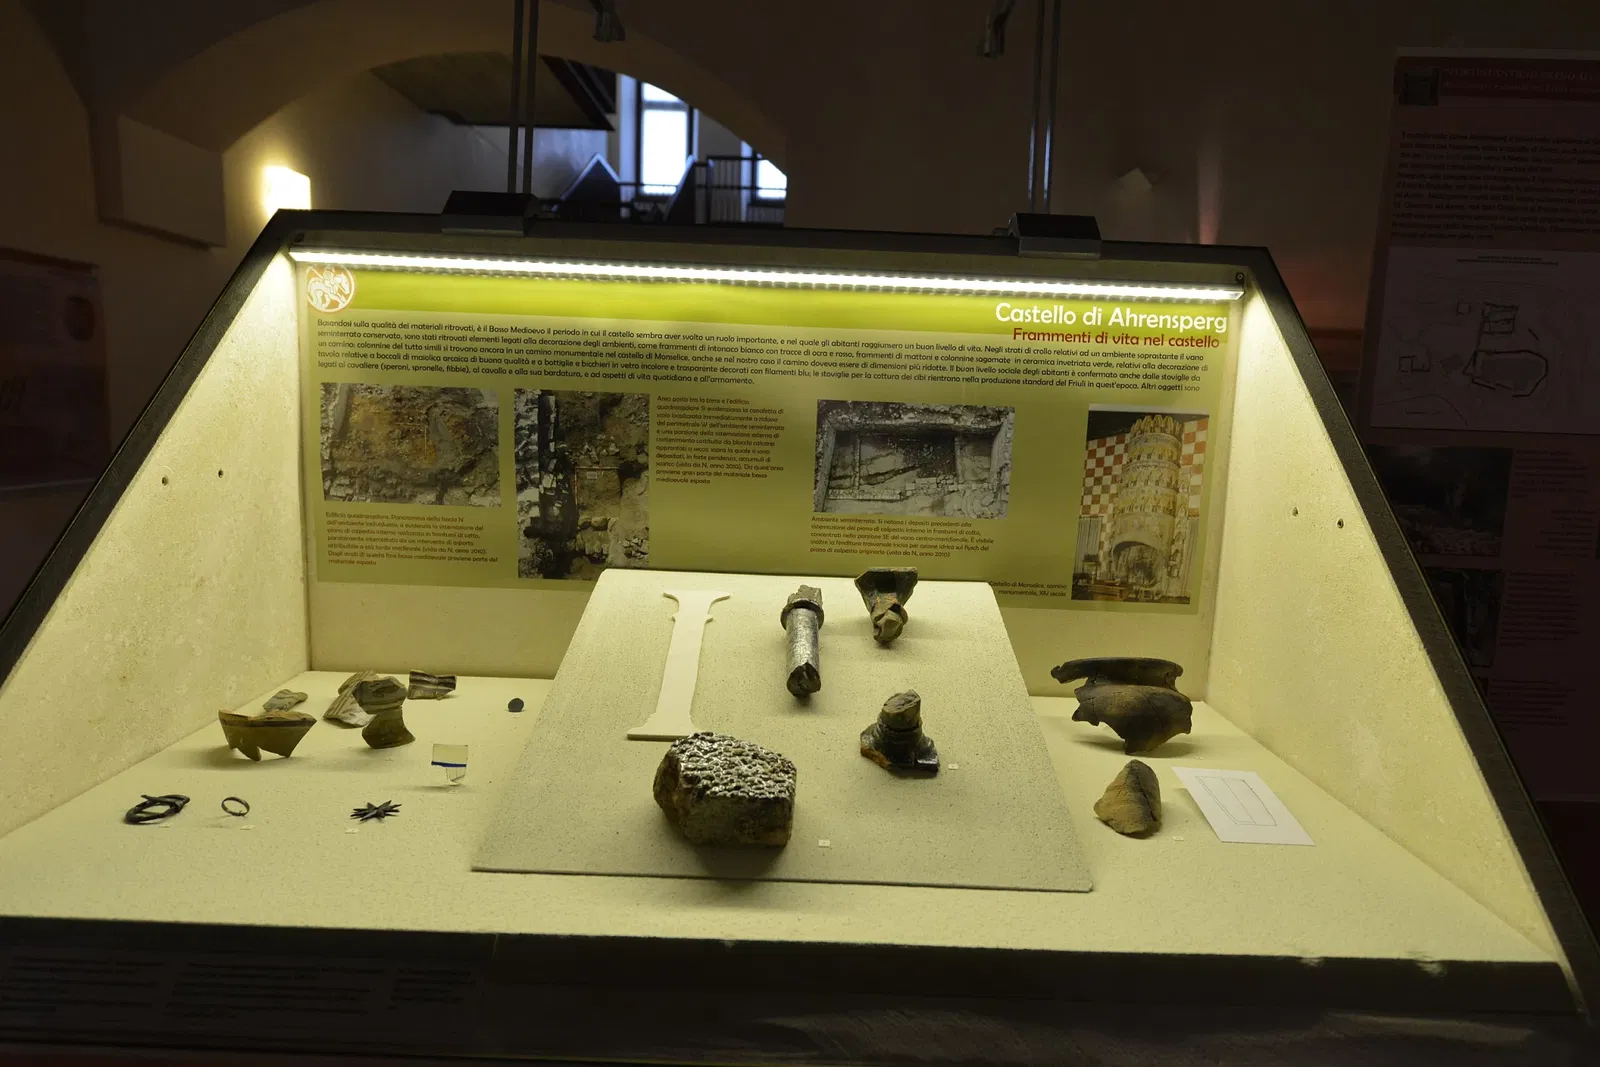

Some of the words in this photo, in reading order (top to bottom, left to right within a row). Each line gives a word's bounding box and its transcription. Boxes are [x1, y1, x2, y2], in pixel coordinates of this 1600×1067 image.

[996, 302, 1076, 324] Castello
[1082, 306, 1102, 326] di
[1108, 307, 1228, 333] Ahrensperg
[1013, 328, 1090, 343] Frammenti
[1096, 331, 1108, 344] di
[1112, 332, 1139, 346] vita
[1144, 332, 1164, 346] nel
[1169, 334, 1220, 348] castello
[318, 318, 352, 327] Basandosi
[354, 319, 370, 327] sulla
[371, 320, 397, 331] qualità
[411, 322, 444, 330] materiali
[444, 323, 476, 333] ritrovati,
[489, 325, 509, 333] Basso
[510, 326, 546, 334] Medioevo
[553, 327, 581, 338] periodo
[590, 329, 601, 337] cui
[608, 330, 635, 338] castello
[636, 331, 663, 339] sembra
[682, 333, 704, 341] svolto
[716, 334, 735, 342] ruolo
[736, 335, 779, 346] importante,
[786, 337, 798, 345] nel
[799, 337, 820, 348] quale
[821, 338, 830, 348] gli
[831, 339, 860, 347] abitanti
[862, 340, 903, 351] raggiunsero
[916, 342, 935, 350] buon
[936, 343, 957, 351] livello
[967, 344, 983, 352] vita.
[984, 345, 1004, 355] Negli
[1005, 346, 1023, 354] strati
[1033, 347, 1052, 355] crollo
[1054, 348, 1078, 356] relativi
[1102, 350, 1136, 358] ambiente
[1137, 351, 1178, 362] soprastante
[318, 329, 362, 338] seminterrato
[363, 330, 403, 340] conservato,
[422, 333, 437, 341] stati
[439, 333, 468, 342] ritrovati
[469, 335, 500, 343] elementi
[501, 336, 522, 346] legati
[523, 337, 537, 345] alla
[538, 337, 582, 346] decorazione
[583, 339, 601, 349] degli
[602, 340, 637, 350] ambienti,
[659, 342, 698, 351] frammenti
[708, 344, 739, 353] intonaco
[740, 345, 764, 354] bianco
[780, 347, 802, 355] tracce
[856, 350, 894, 359] frammenti
[904, 352, 933, 360] mattoni
[941, 353, 974, 362] colonnine
[976, 355, 1013, 366] sagomate
[1023, 356, 1055, 365] ceramica
[1056, 358, 1091, 367] invetriata
[1093, 359, 1114, 369] verde,
[1116, 360, 1141, 369] relativi
[1142, 361, 1156, 369] alla
[1157, 362, 1200, 371] decorazione
[328, 339, 356, 348] camino:
[357, 340, 391, 349] colonnine
[405, 342, 423, 350] tutto
[424, 343, 442, 351] simili
[450, 344, 478, 353] trovano
[526, 347, 552, 356] camino
[554, 348, 604, 358] monumentale
[605, 350, 616, 358] nel
[618, 351, 644, 359] castello
[654, 352, 690, 362] Monselice,
[692, 354, 714, 362] anche
[736, 356, 758, 364] nostro
[783, 357, 809, 366] camino
[810, 358, 837, 367] doveva
[870, 361, 908, 370] dimensioni
[909, 362, 921, 372] più
[922, 363, 948, 372] ridotte.
[956, 364, 974, 373] buon
[976, 365, 996, 374] livello
[998, 366, 1021, 374] sociale
[1023, 367, 1040, 377] degli
[1042, 368, 1070, 376] abitanti
[1077, 369, 1118, 378] confermato
[1119, 371, 1141, 379] anche
[1142, 372, 1160, 380] dalle
[1162, 373, 1190, 383] stoviglie
